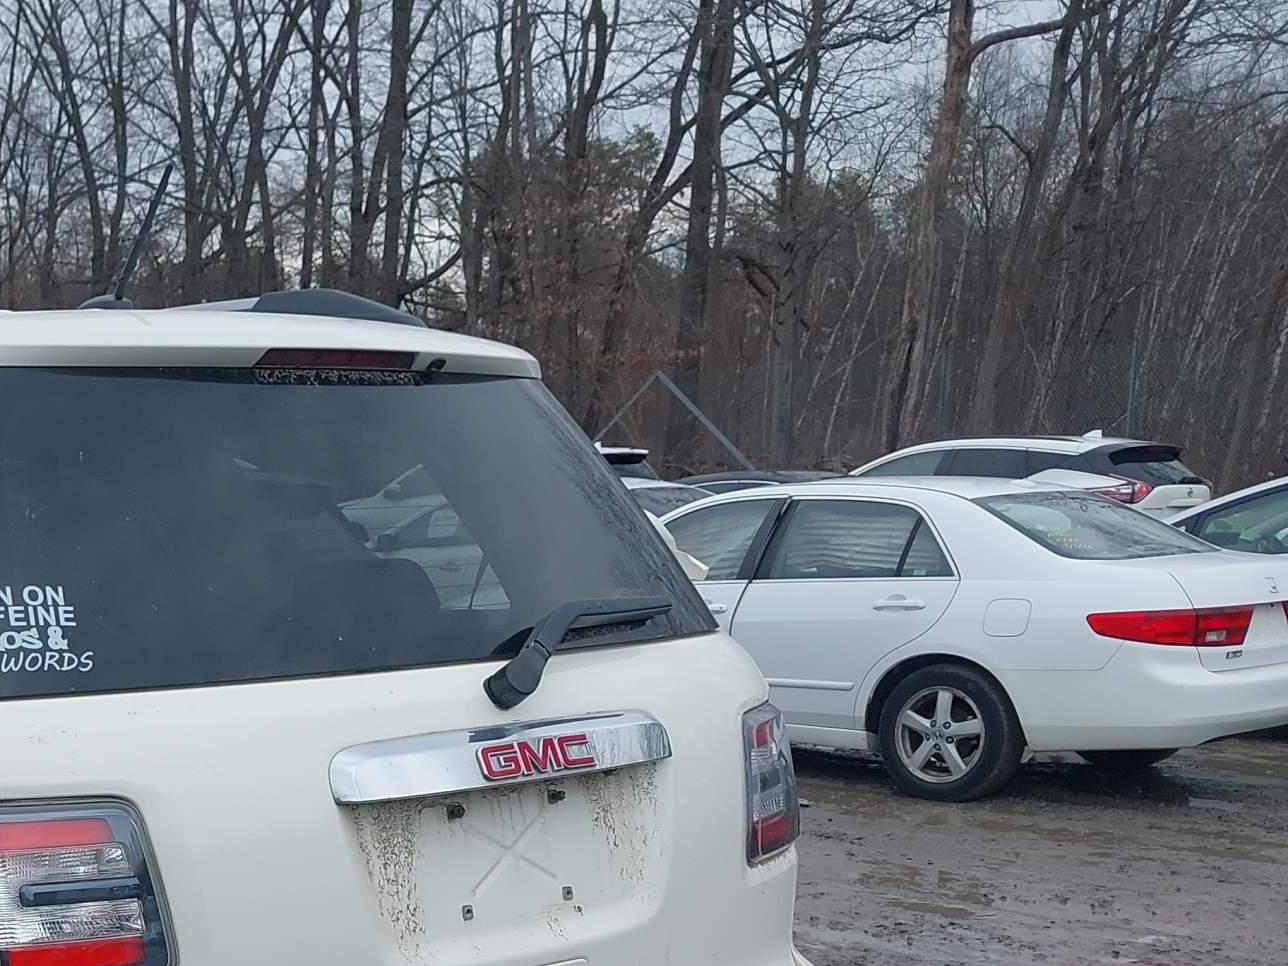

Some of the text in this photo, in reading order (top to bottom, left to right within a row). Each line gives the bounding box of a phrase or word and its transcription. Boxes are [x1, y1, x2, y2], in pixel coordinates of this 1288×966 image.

[23, 585, 65, 606] ON
[47, 626, 69, 650] &
[1, 651, 94, 672] WORDS
[477, 734, 598, 780] GMC
